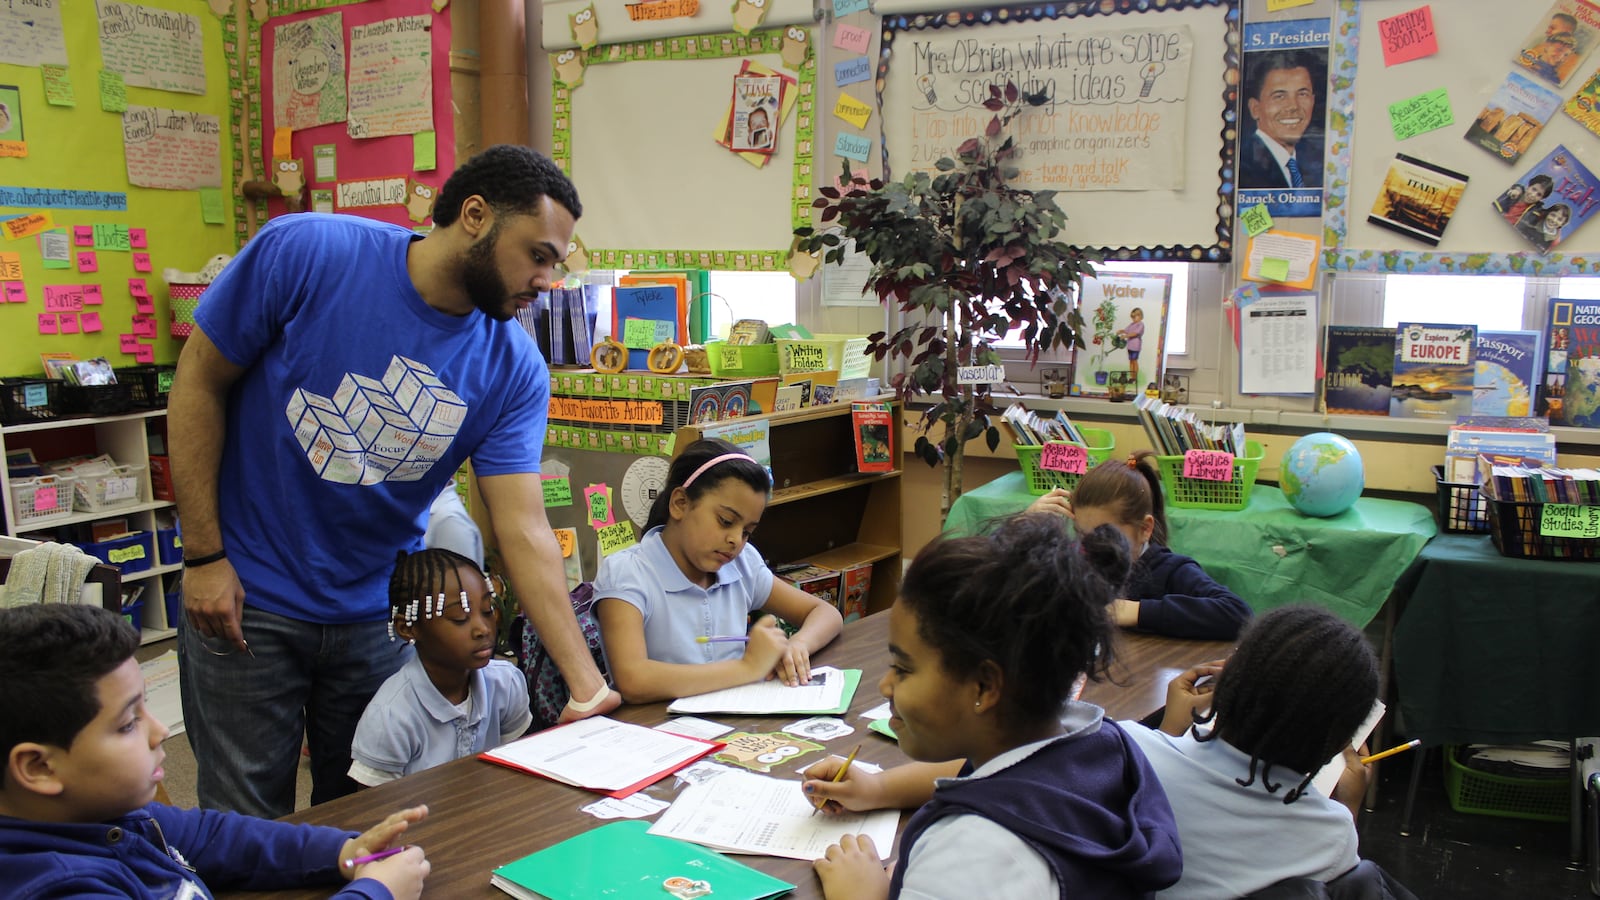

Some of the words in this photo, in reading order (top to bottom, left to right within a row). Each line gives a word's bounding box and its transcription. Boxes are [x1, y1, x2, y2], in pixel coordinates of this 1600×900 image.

[1380, 9, 1427, 39] Coming
[1018, 33, 1072, 70] what
[1077, 37, 1113, 67] are
[1120, 33, 1181, 64] some
[1073, 67, 1127, 100] ideas
[919, 111, 948, 142] Tap
[951, 111, 977, 137] into
[1069, 102, 1161, 137] knowledge
[341, 182, 381, 206] Reading
[1407, 178, 1440, 196] ITALY
[1238, 194, 1276, 204] Barack
[1279, 192, 1321, 204] Obama
[1102, 284, 1145, 299] Water
[1424, 333, 1449, 343] Explore
[791, 344, 824, 360] Writing
[1410, 344, 1462, 360] EUROPE
[1476, 336, 1526, 361] Passport
[794, 356, 825, 369] Folders
[1327, 371, 1363, 387] EUROPE
[557, 400, 581, 419] Your
[580, 400, 620, 421] Favorite
[623, 400, 664, 422] Author?
[315, 435, 333, 453] have
[373, 444, 406, 454] Focus
[393, 430, 415, 446] Work
[417, 439, 440, 454] Hard
[311, 450, 326, 466] fun
[411, 461, 431, 470] Love
[1043, 454, 1083, 474] Library
[1188, 450, 1229, 468] Science
[1189, 465, 1227, 481] Library
[1545, 504, 1582, 518] Social
[1542, 516, 1585, 532] Studies
